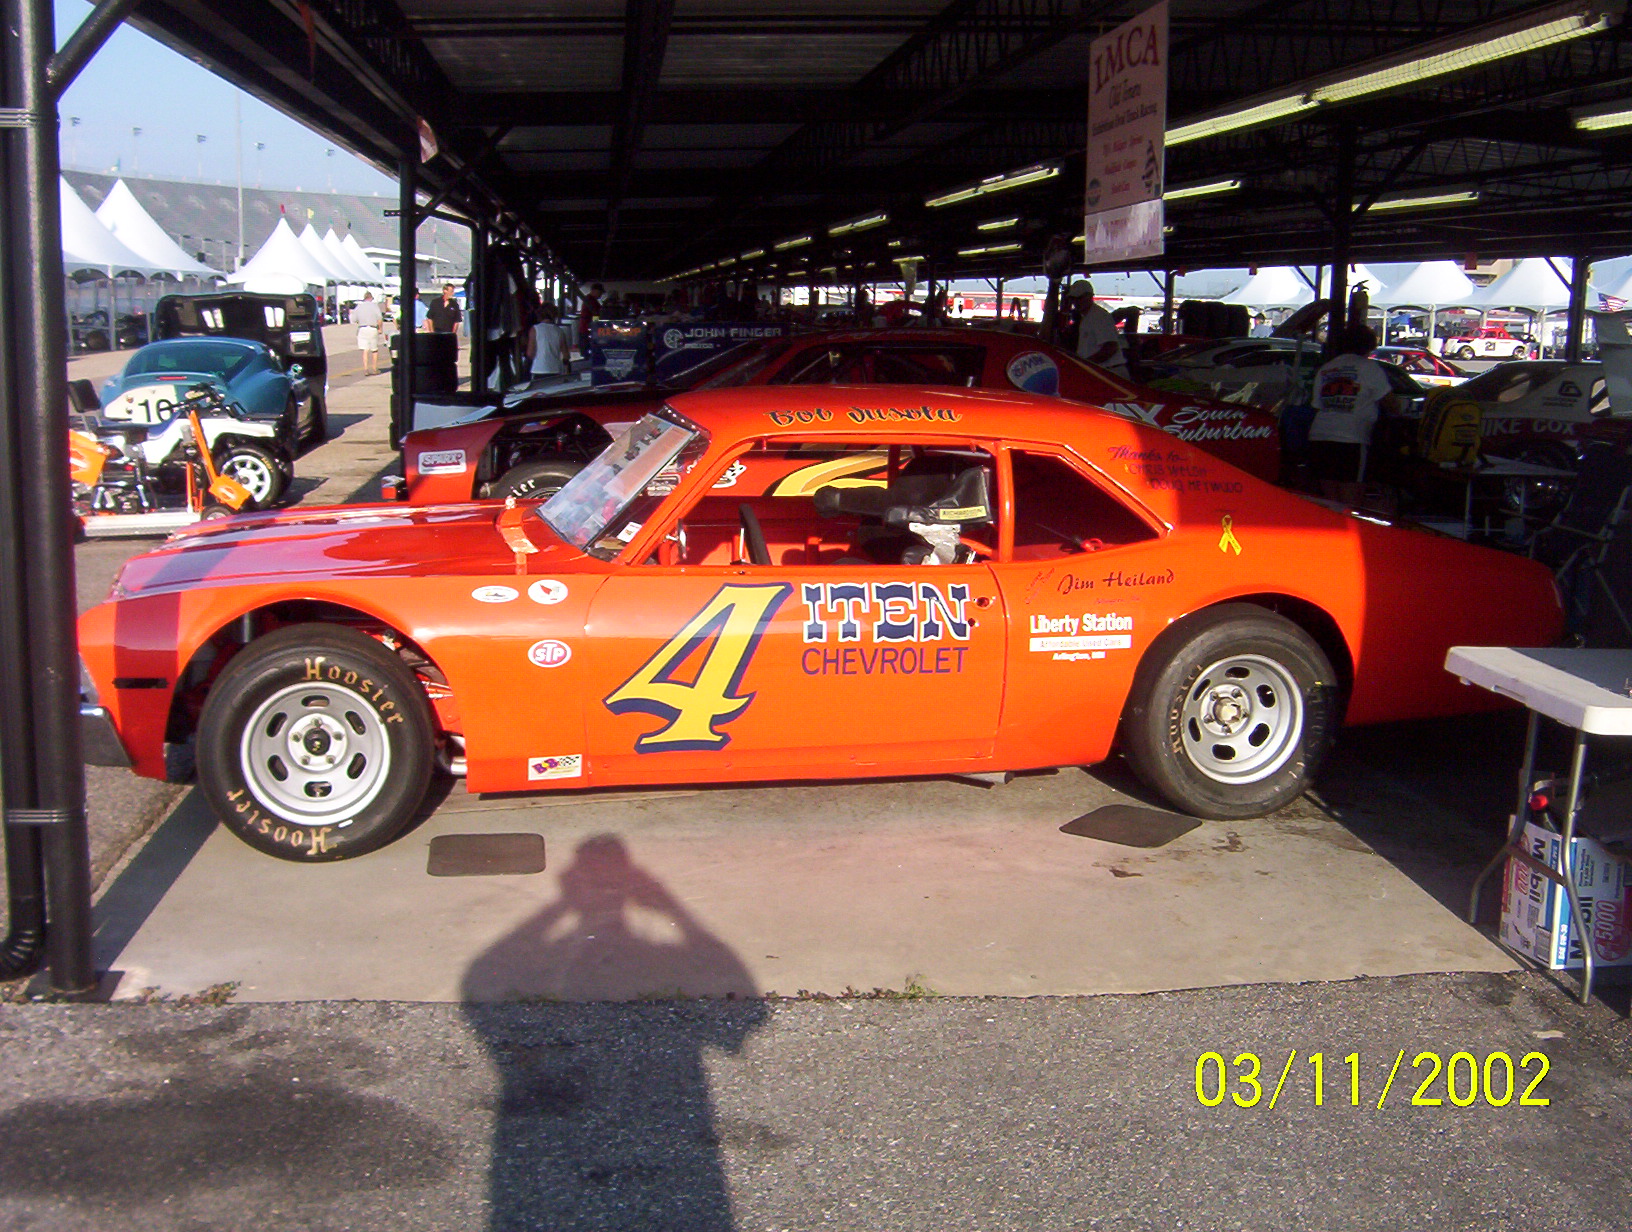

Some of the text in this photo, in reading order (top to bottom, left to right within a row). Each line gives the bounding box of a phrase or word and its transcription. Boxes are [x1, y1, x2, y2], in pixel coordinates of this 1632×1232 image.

[1095, 25, 1159, 93] IMCA
[685, 328, 782, 338] JOHN FINGER
[1162, 422, 1274, 441] Suburban
[1480, 418, 1521, 437] IKE
[1108, 445, 1162, 460] Thanks
[1057, 573, 1094, 595] Jim
[1102, 568, 1175, 588] Heiland
[801, 582, 971, 643] ITEN
[1029, 612, 1133, 636] Liberty Station
[535, 643, 566, 663] STP
[801, 647, 969, 675] CHEVROLET
[602, 582, 794, 754] 4
[302, 656, 404, 725] Hoosier
[226, 788, 338, 856] Hoosier
[1529, 837, 1547, 903] Mbil
[1595, 900, 1617, 941] 5000
